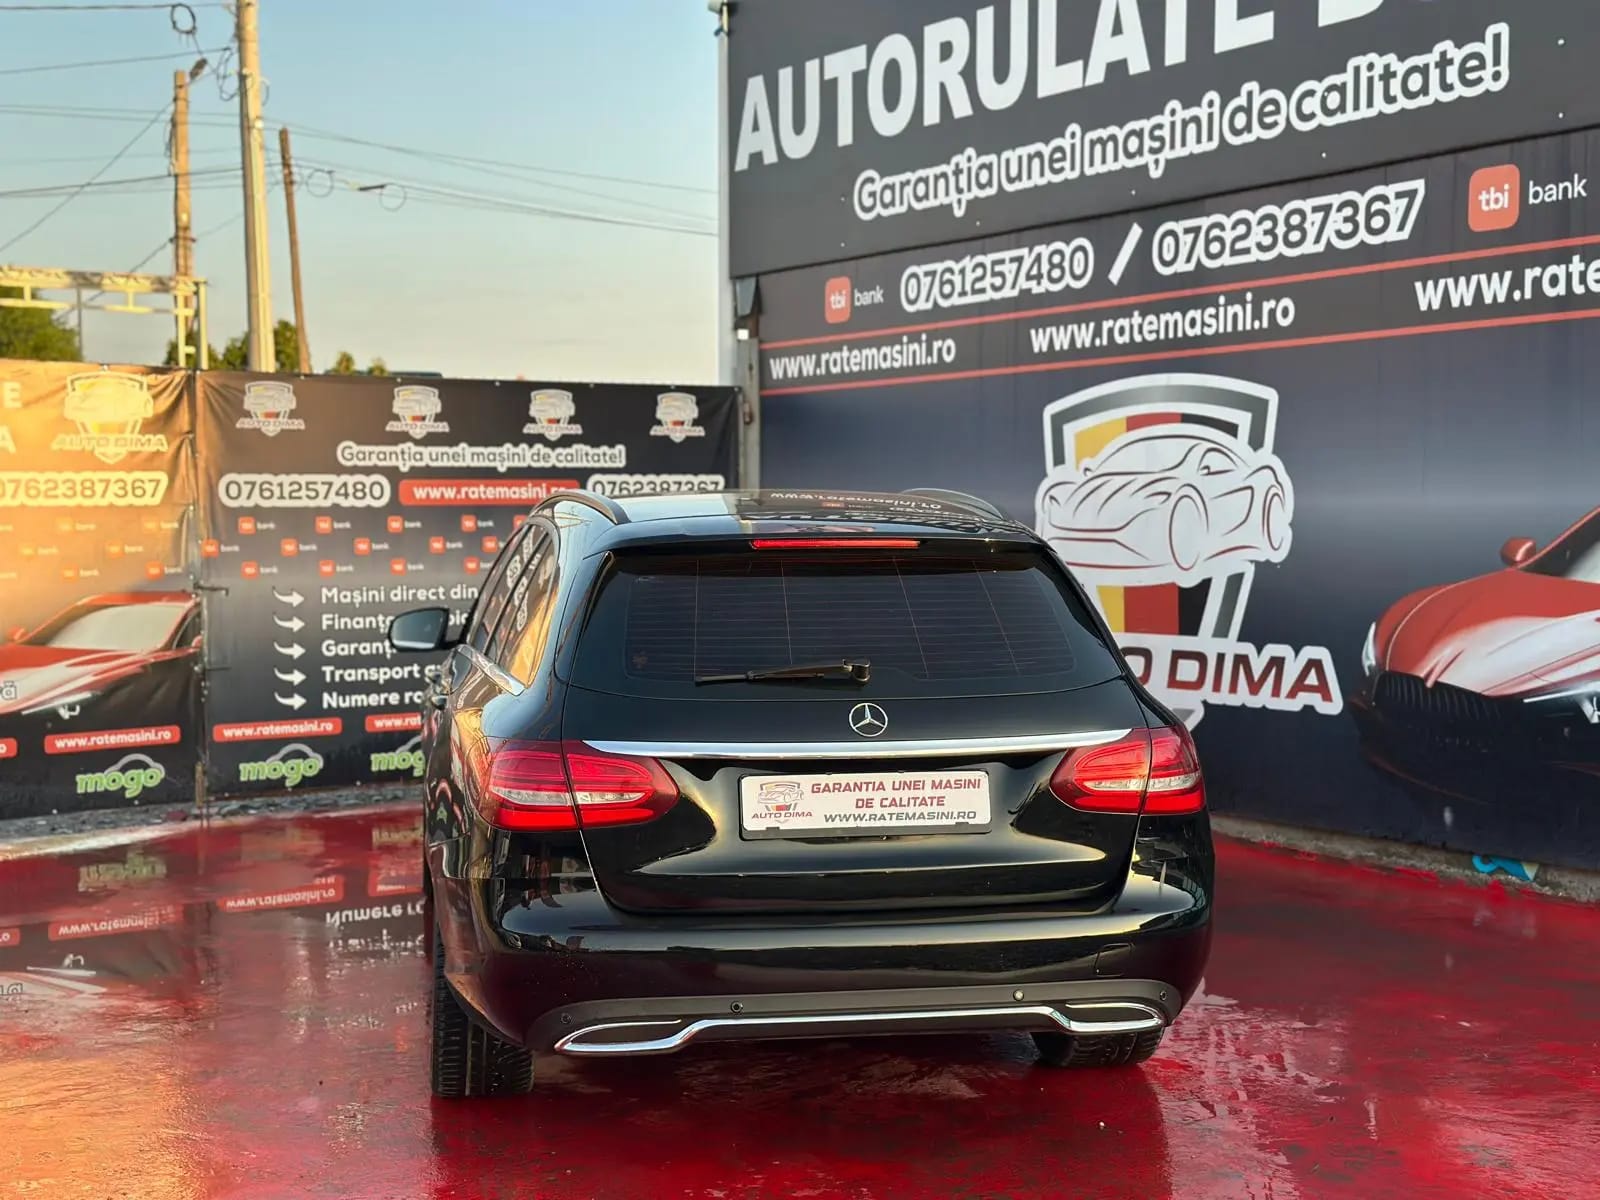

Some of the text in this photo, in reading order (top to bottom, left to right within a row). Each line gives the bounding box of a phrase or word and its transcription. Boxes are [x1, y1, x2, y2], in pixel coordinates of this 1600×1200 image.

[857, 30, 1504, 215] Garanția unei mașini de calitate!
[1478, 173, 1587, 212] tbi bank
[903, 241, 1092, 307] 0761257480
[1156, 187, 1420, 270] 0762387367
[829, 285, 884, 310] tbi bank
[1030, 291, 1296, 354] www.ratemasini.ro
[769, 333, 956, 381] www.ratemasini.ro
[340, 445, 624, 469] Garanția unei mașini de calitate!
[225, 480, 385, 501] 0761257480
[321, 584, 478, 608] Mașini direct din
[321, 639, 398, 660] Garanț
[321, 663, 421, 685] Transport
[1166, 648, 1334, 704] DIMA
[322, 691, 401, 710] Numere
[55, 728, 172, 749] www.ratemasini.ro
[223, 719, 334, 738] www.ratemasini.ro
[75, 767, 163, 798] mogo
[239, 757, 321, 787] mogo
[811, 778, 981, 794] GARANTIA UNEI MASINI
[855, 796, 946, 809] DE CALITATE
[751, 811, 813, 820] AUTO DIMA
[823, 810, 977, 823] WWW.RATEMASINI.RO
